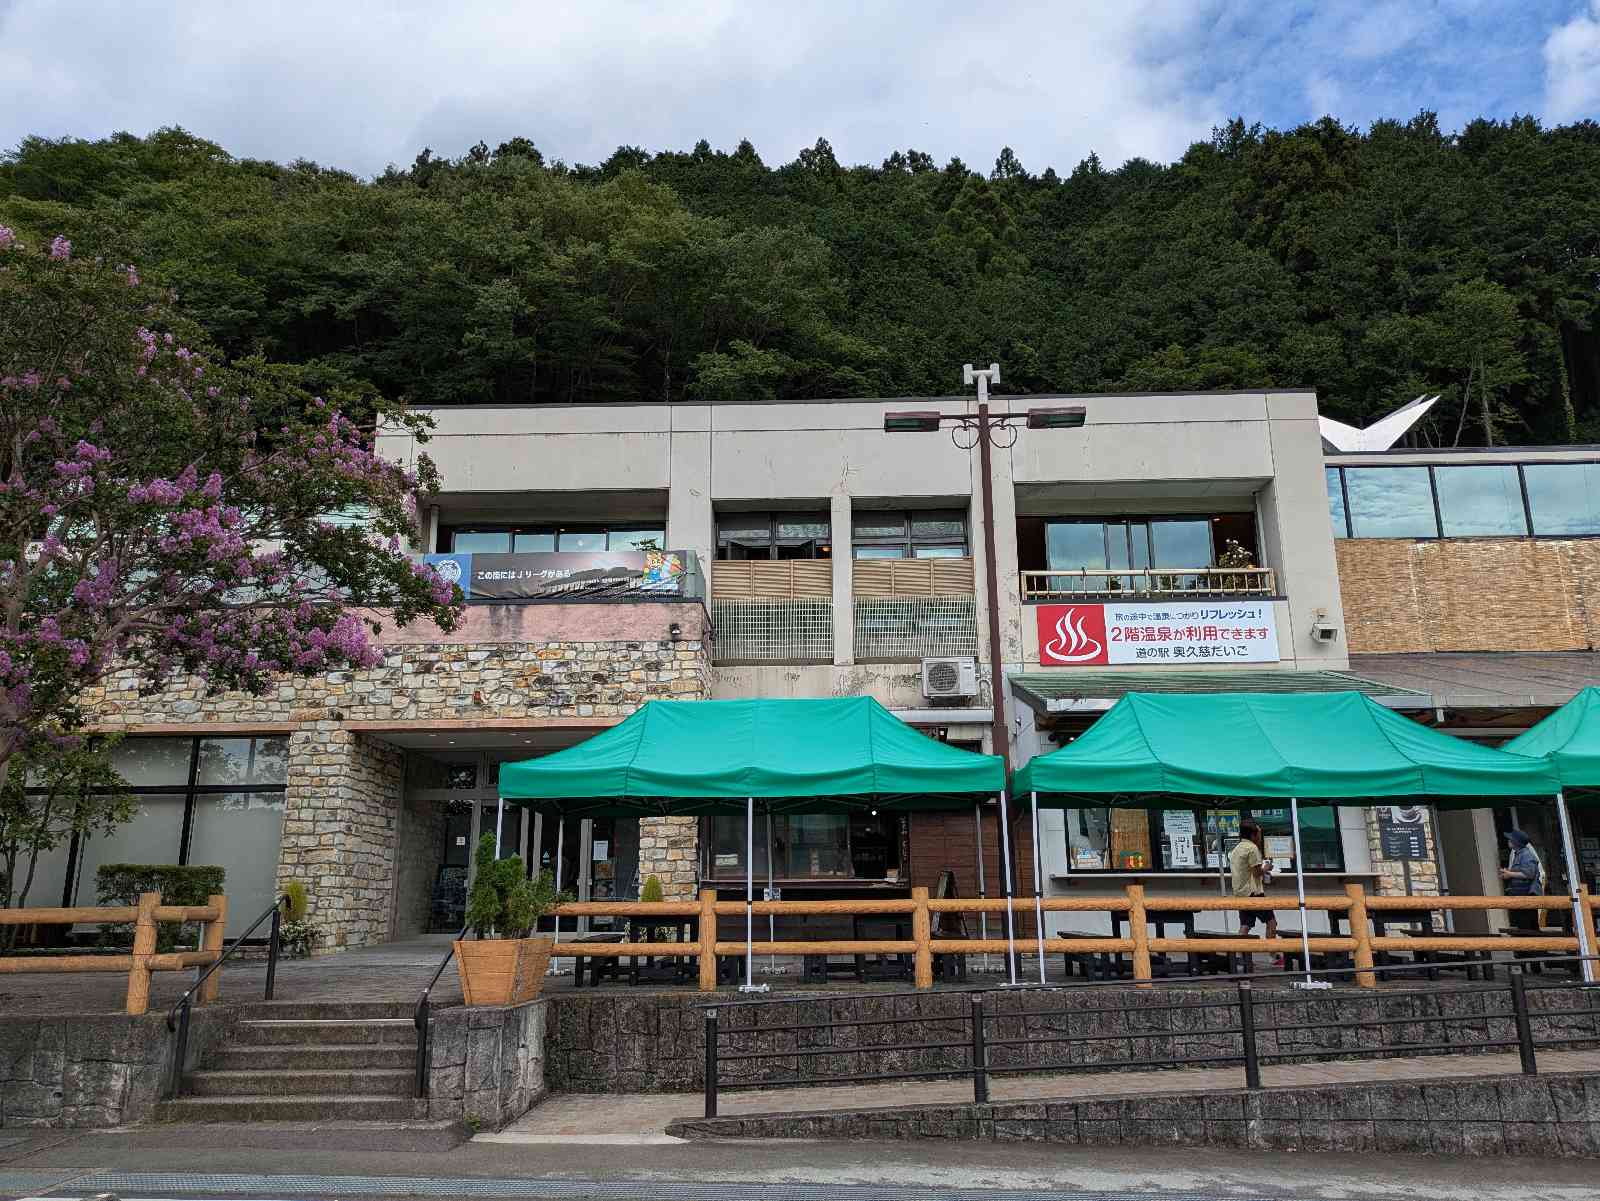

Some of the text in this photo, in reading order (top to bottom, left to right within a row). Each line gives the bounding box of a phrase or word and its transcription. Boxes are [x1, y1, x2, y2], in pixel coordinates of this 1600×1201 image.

[1111, 625, 1269, 642] 2階温泉が利用できます
